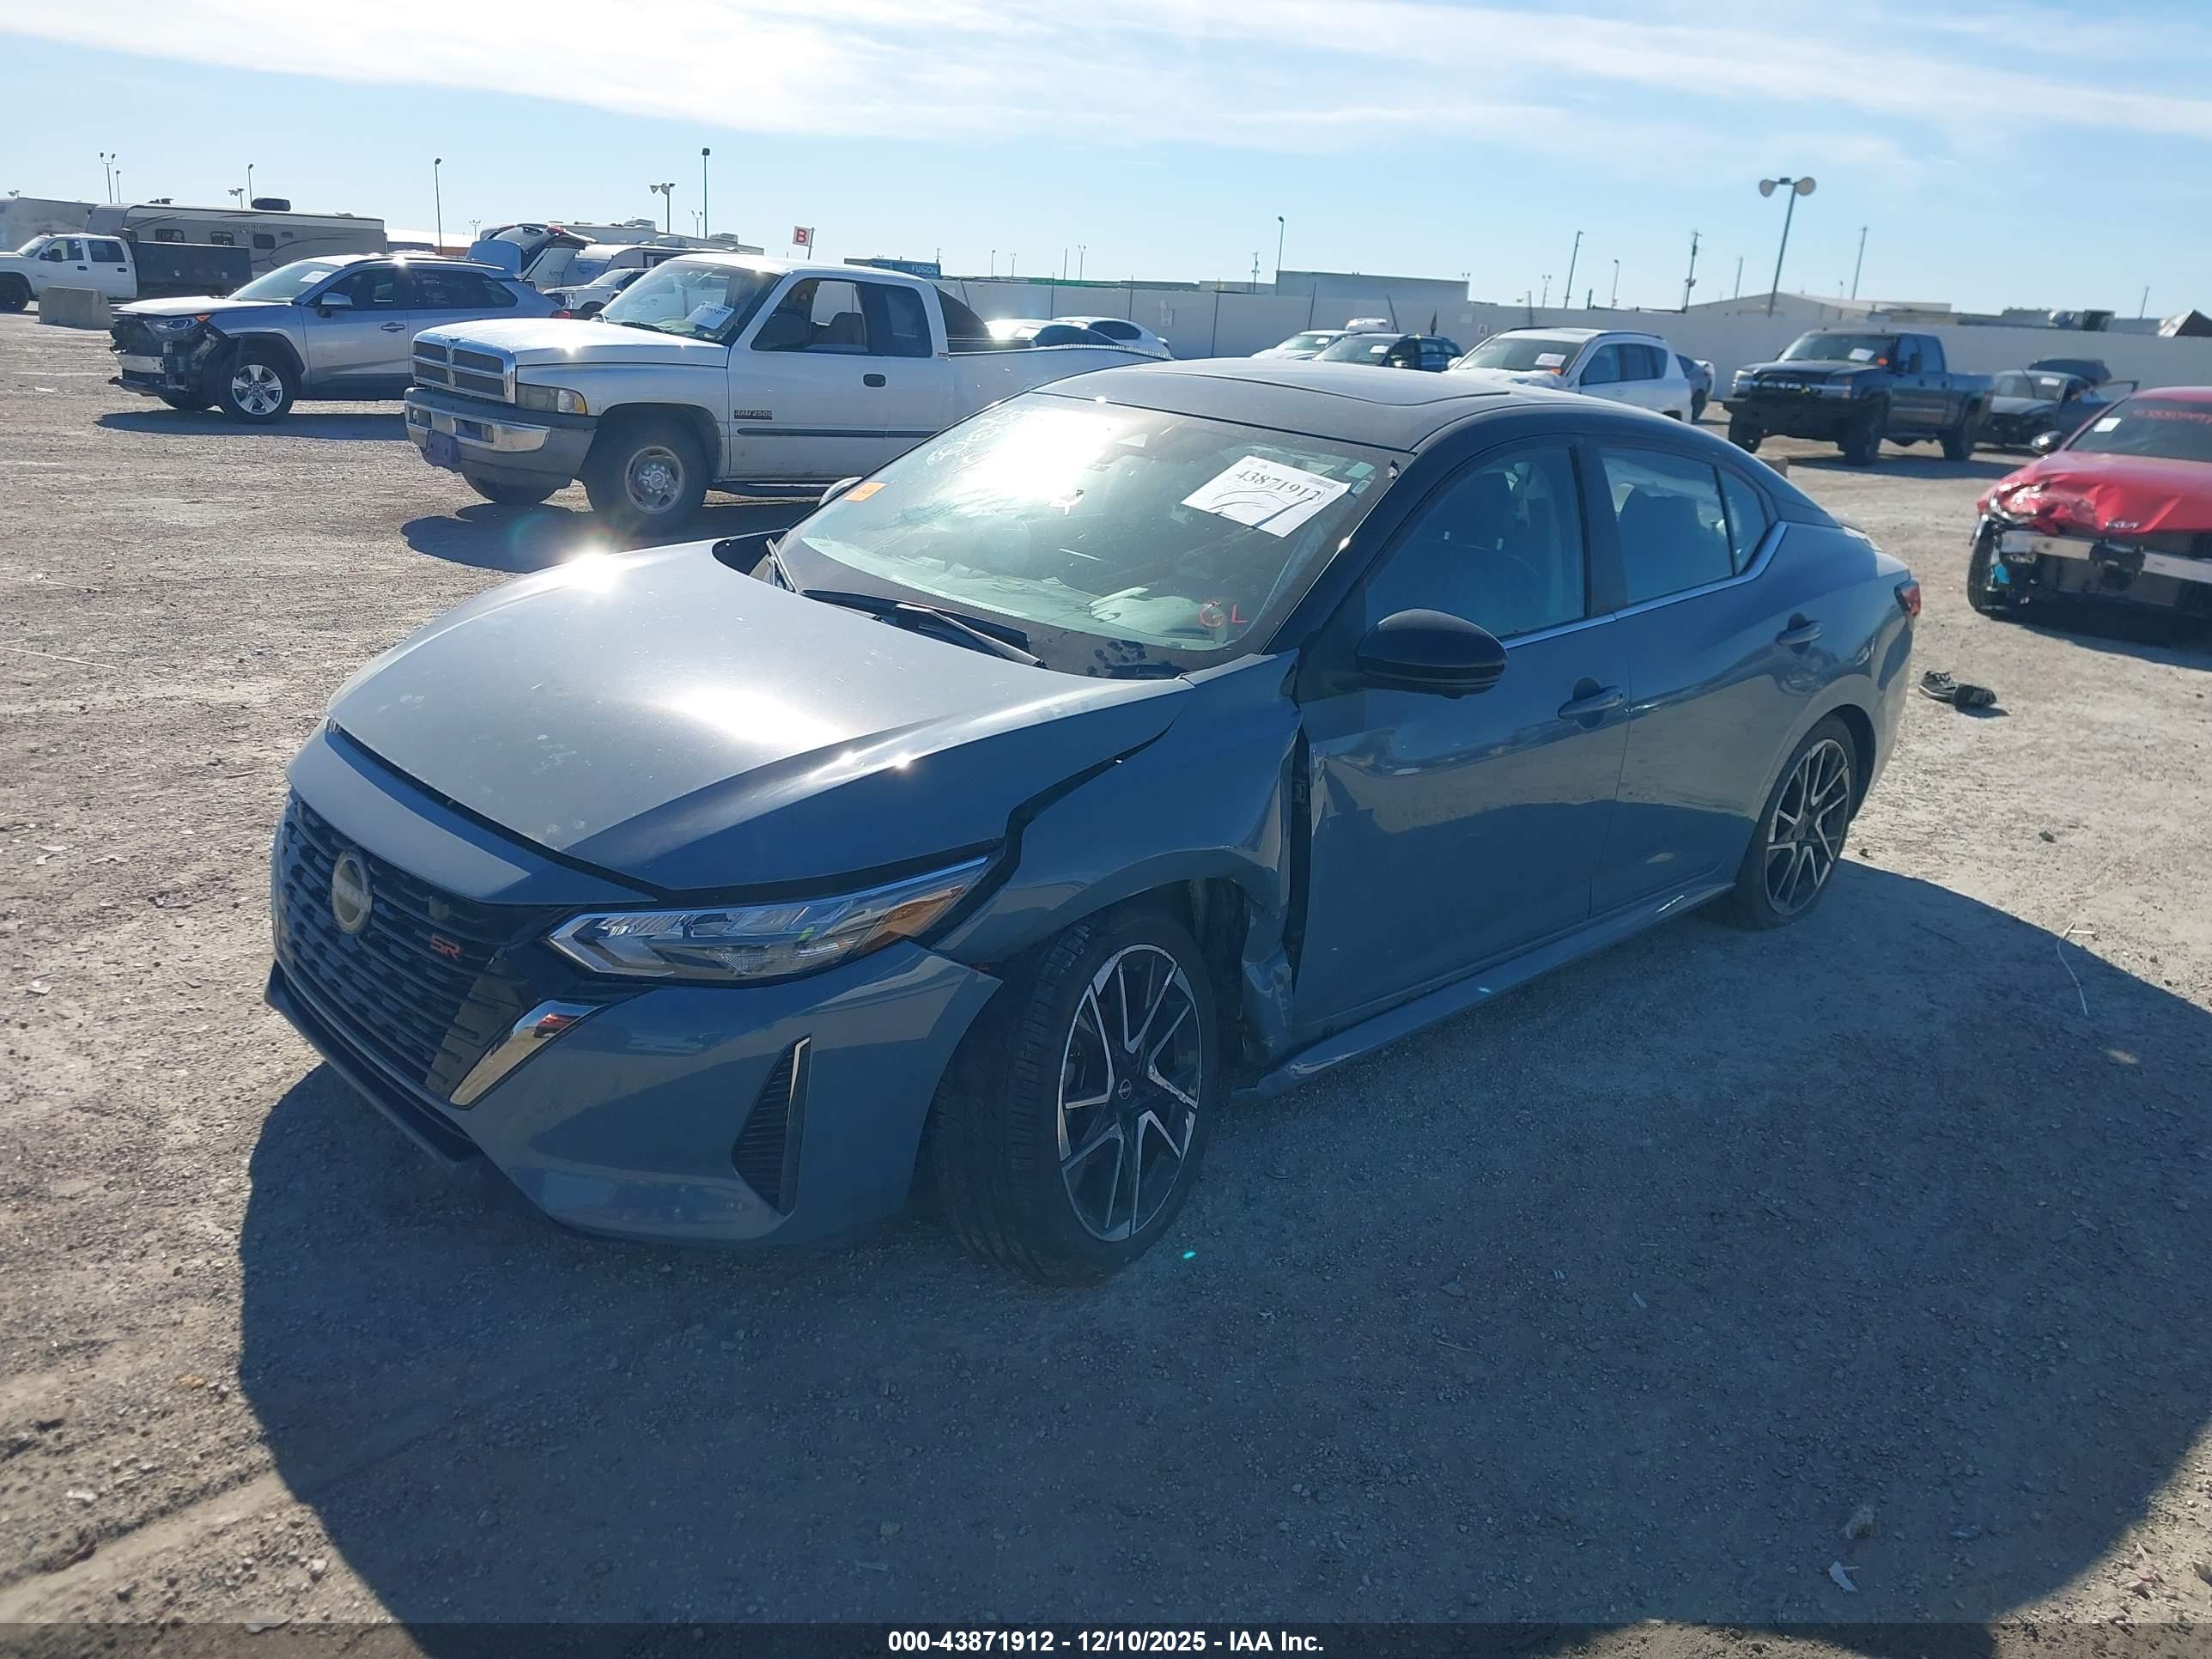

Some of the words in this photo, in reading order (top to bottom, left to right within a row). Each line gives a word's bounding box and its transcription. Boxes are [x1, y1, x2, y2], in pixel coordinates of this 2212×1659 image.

[795, 228, 807, 244] B
[911, 264, 939, 275] FUSION
[1479, 325, 1486, 335] A
[428, 933, 461, 963] SR
